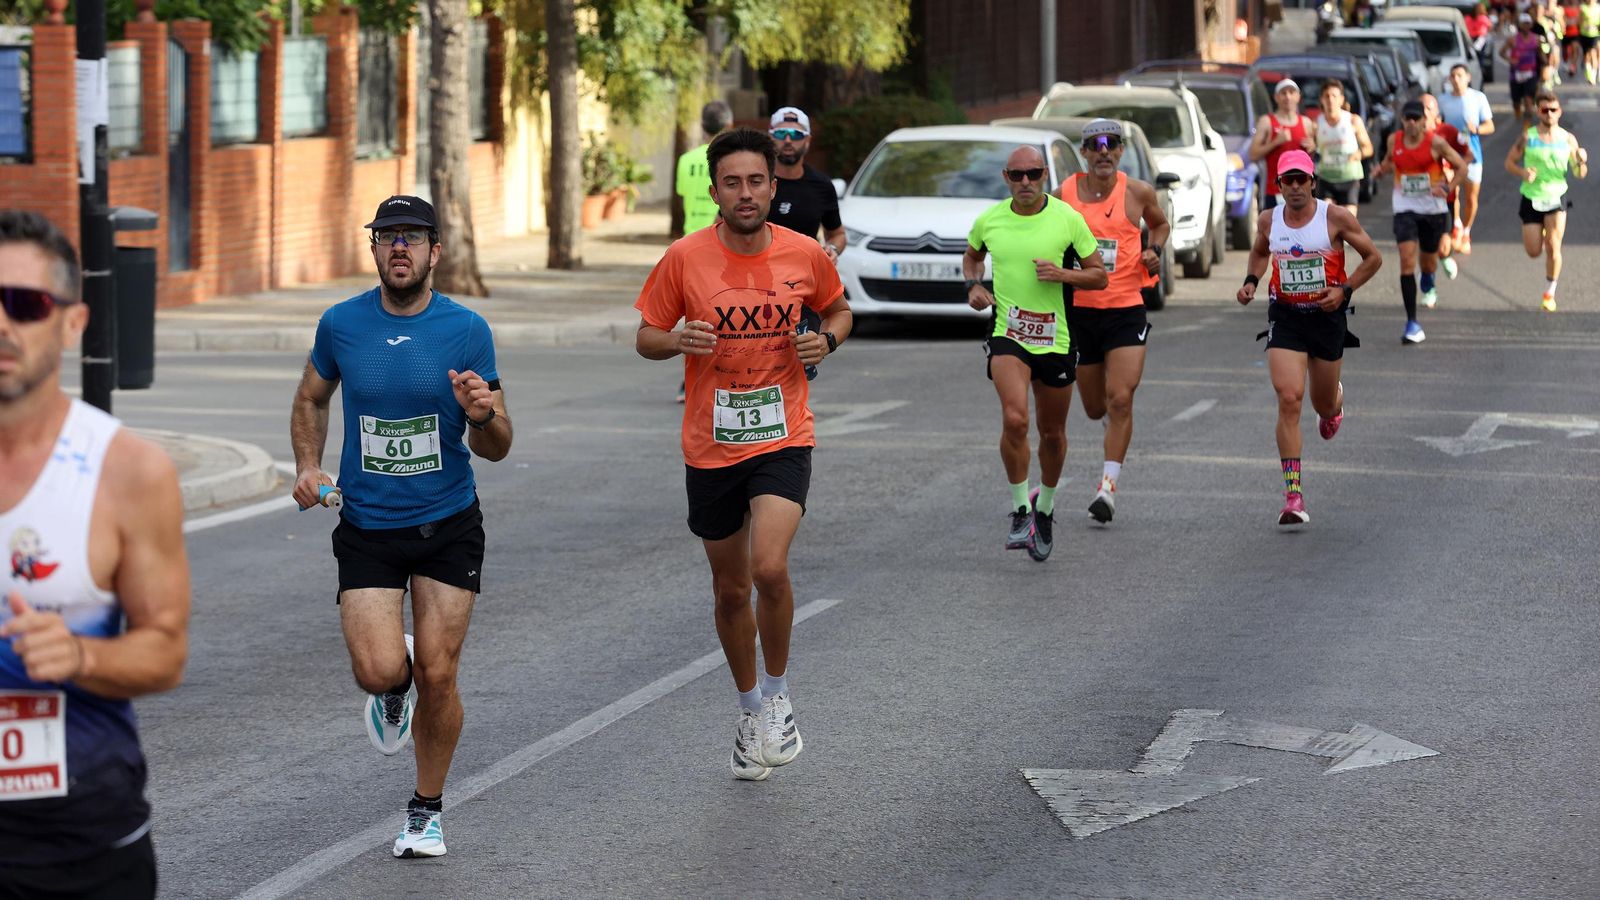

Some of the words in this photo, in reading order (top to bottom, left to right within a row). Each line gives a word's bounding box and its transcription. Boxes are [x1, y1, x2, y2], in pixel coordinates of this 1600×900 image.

[1290, 269, 1314, 282] 113
[744, 331, 781, 339] MARATÓN
[1018, 321, 1045, 335] 298
[736, 408, 762, 428] 13
[385, 438, 413, 458] 60
